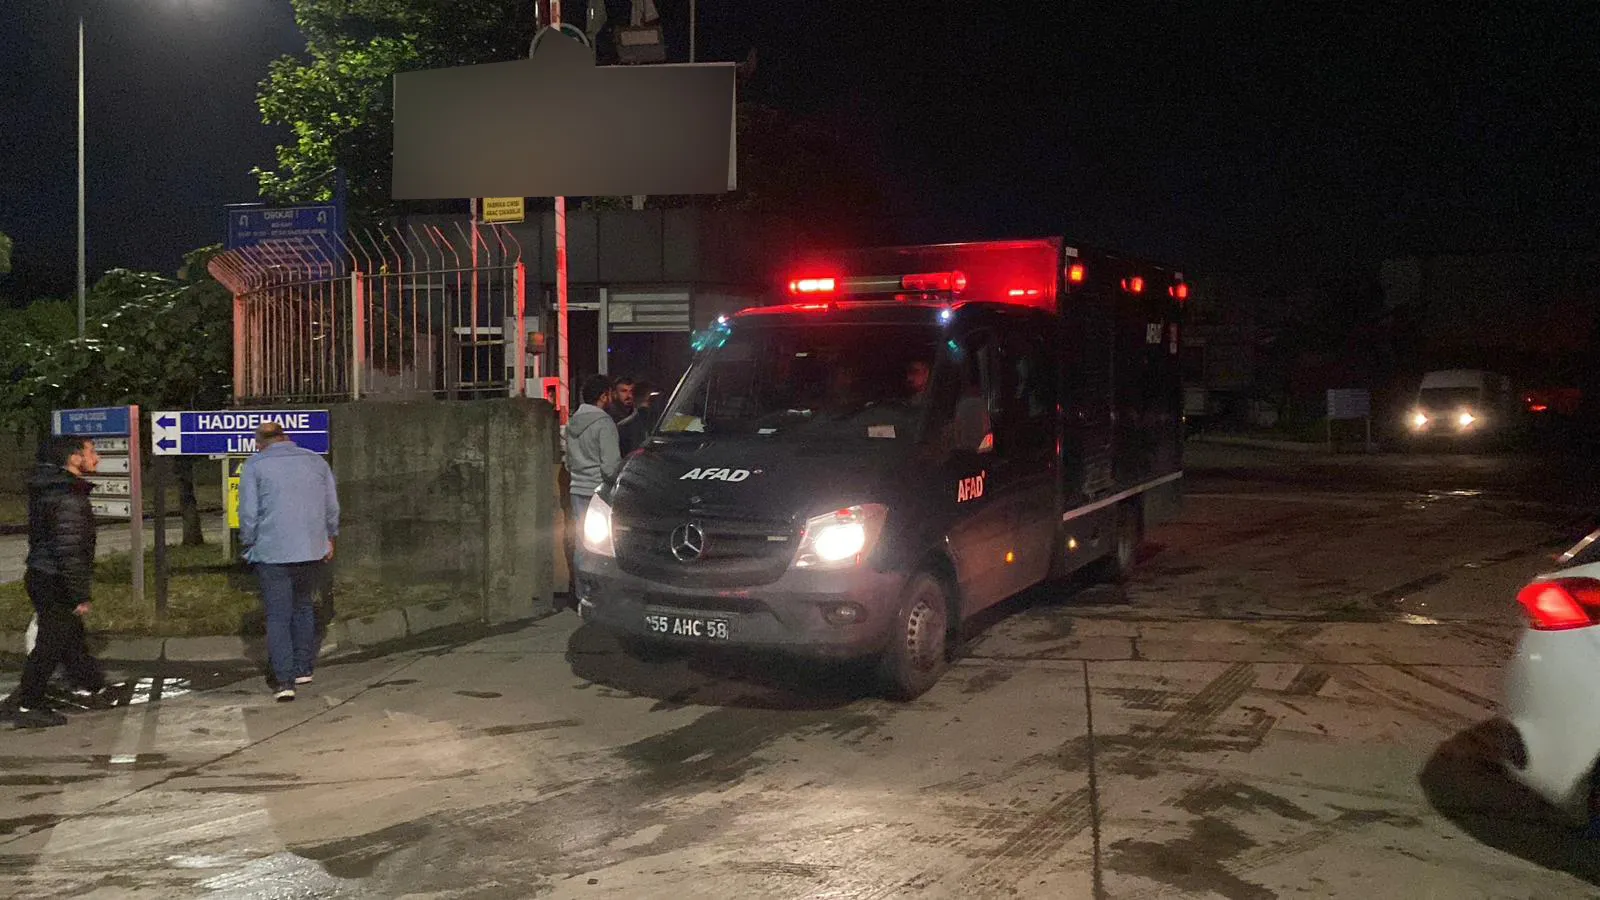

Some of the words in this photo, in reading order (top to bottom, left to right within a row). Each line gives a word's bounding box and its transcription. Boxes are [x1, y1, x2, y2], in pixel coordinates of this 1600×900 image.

[198, 414, 310, 430] HADDEHANE
[227, 435, 260, 453] LİM
[679, 467, 751, 483] AFAD
[957, 475, 984, 503] AFAD
[650, 615, 669, 633] 55
[672, 618, 702, 637] AHC
[706, 621, 728, 639] 58
